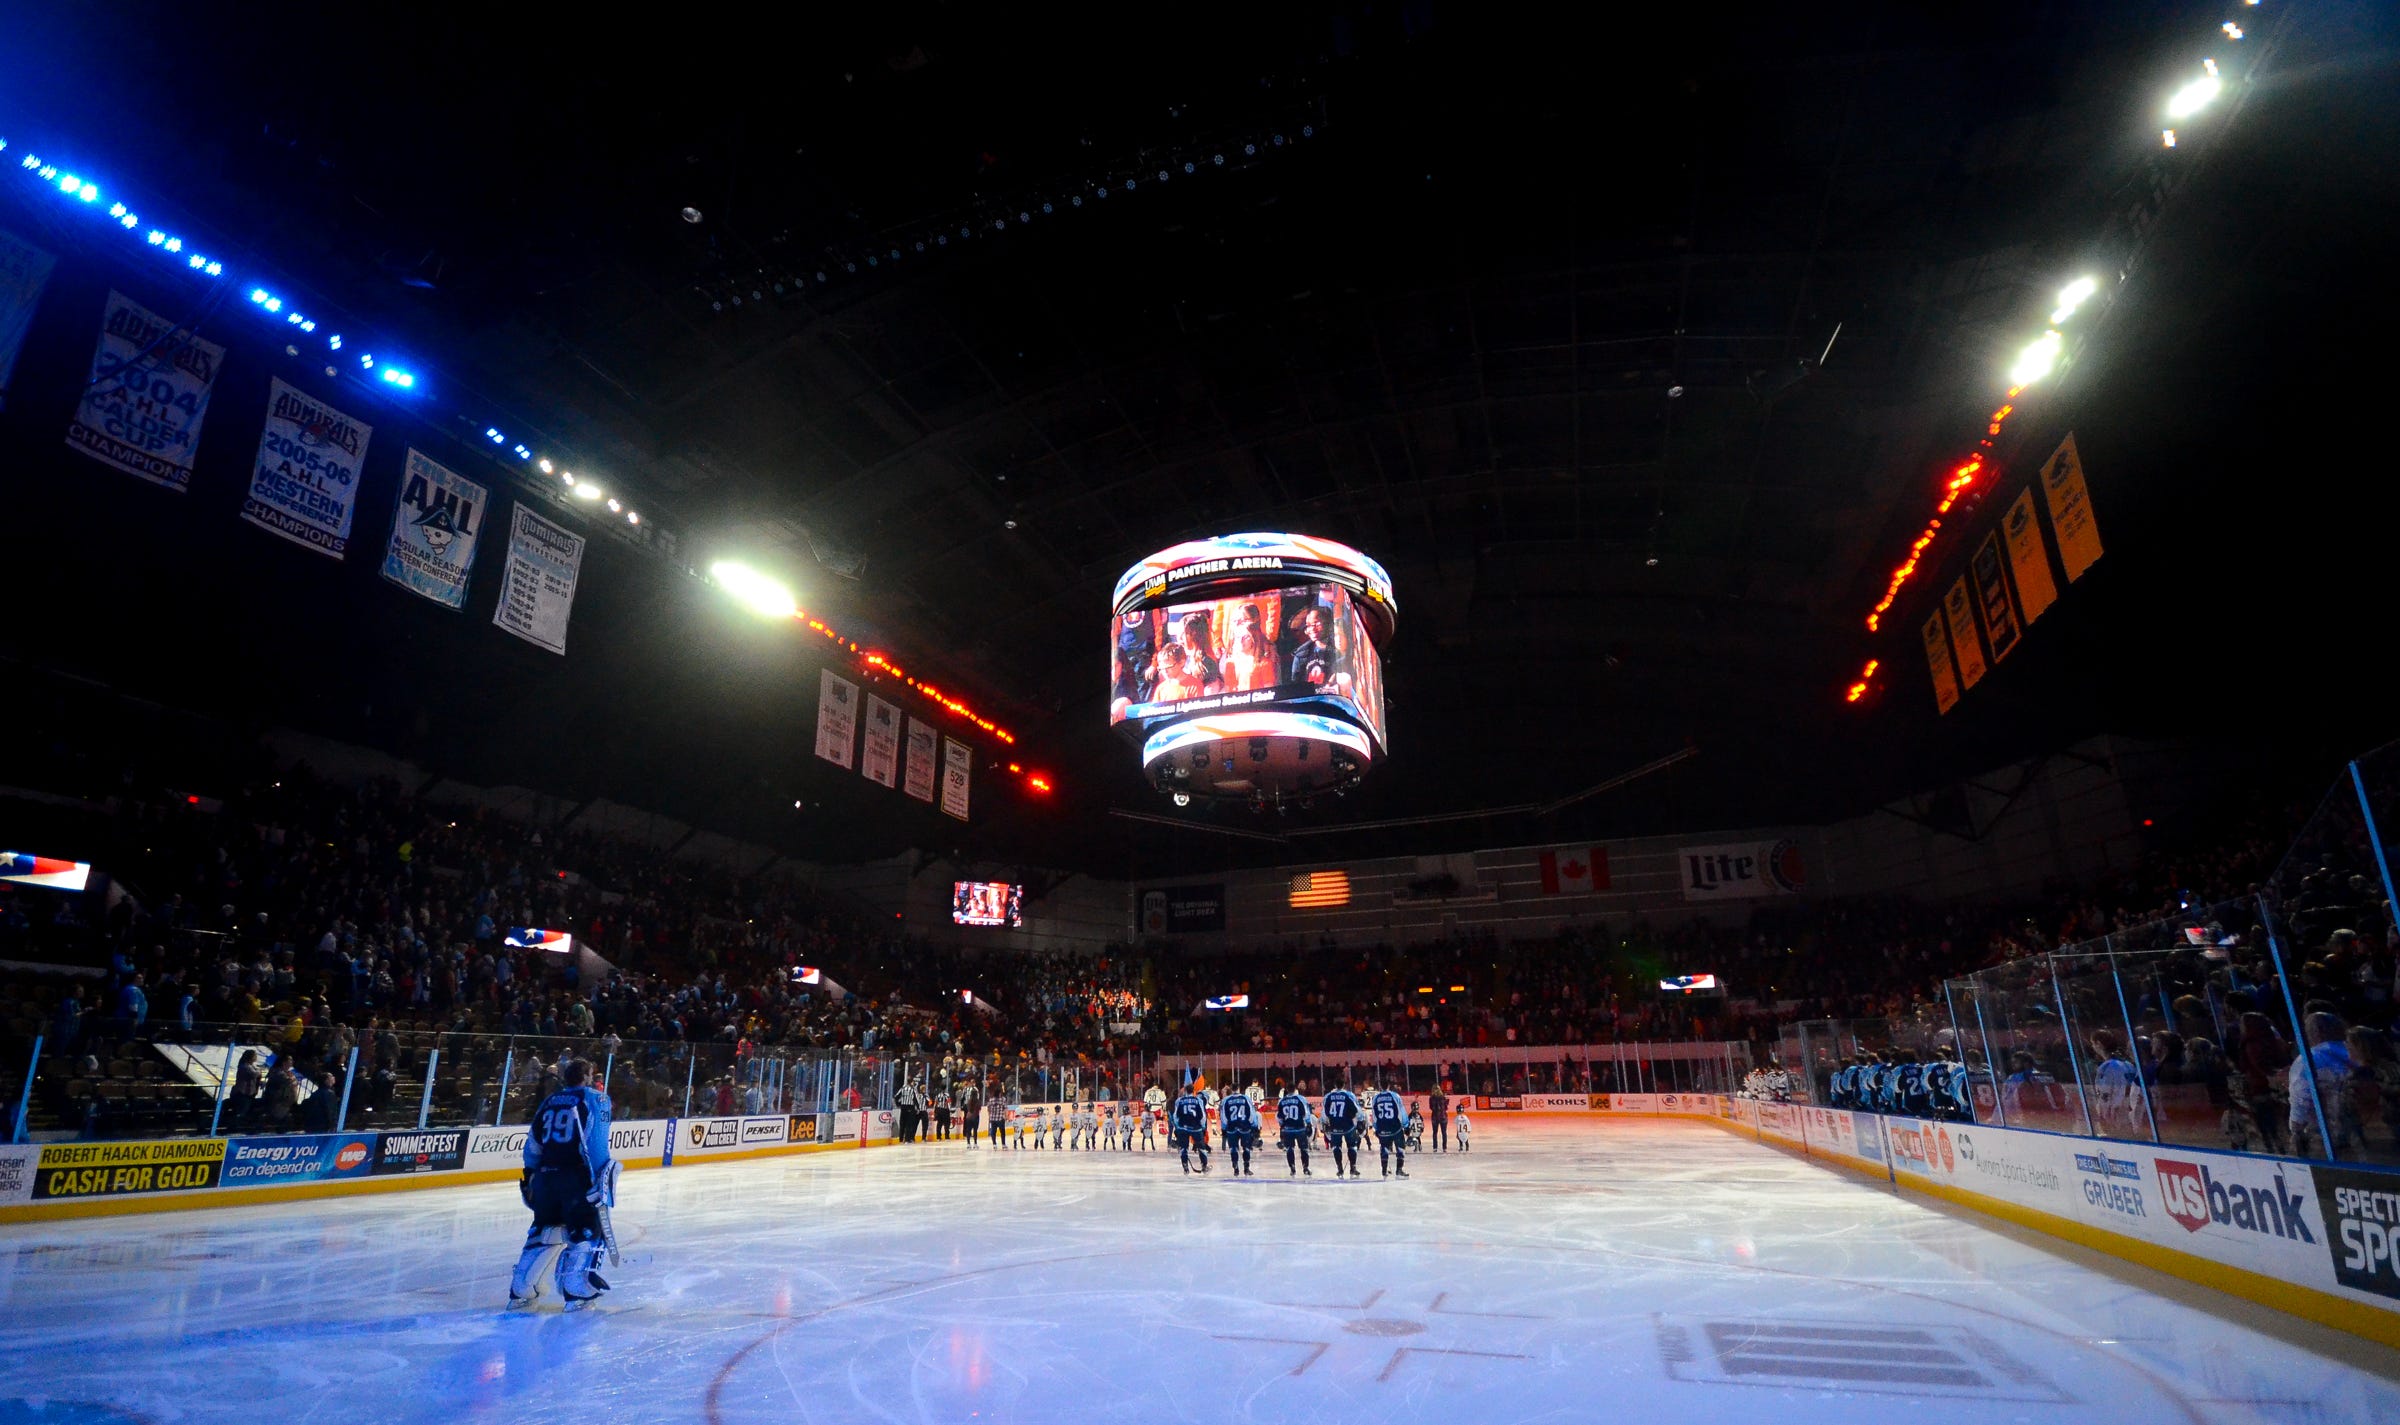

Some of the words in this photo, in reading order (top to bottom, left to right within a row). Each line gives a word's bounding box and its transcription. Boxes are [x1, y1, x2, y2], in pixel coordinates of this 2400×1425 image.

[96, 352, 198, 416] 2004
[90, 396, 189, 448] CALDER
[104, 418, 166, 451] CUP
[272, 392, 358, 458] ADMIRALS
[68, 423, 191, 483] CHAMPIONS
[266, 432, 352, 485] 2005-06
[254, 483, 341, 529] CONFERENCE
[258, 466, 344, 518] WESTERN
[402, 474, 473, 536] AHL
[244, 500, 345, 551] CHAMPIONS
[520, 513, 576, 558] ADMIRALS
[431, 552, 467, 577] SEASON
[1168, 559, 1229, 582] PANTHER
[1232, 557, 1283, 570] ARENA
[1685, 854, 1753, 890] Lite
[1183, 1104, 1196, 1117] 15
[1230, 1105, 1246, 1121] 24
[1329, 1101, 1345, 1118] 47
[1378, 1102, 1395, 1119] 55
[1523, 1097, 1544, 1109] Lee
[1547, 1098, 1587, 1106] KOHL'S
[1590, 1096, 1611, 1109] Lee
[541, 1109, 575, 1143] 39
[664, 1122, 674, 1155] CCM
[706, 1134, 719, 1146] OUR
[710, 1122, 724, 1134] OUR
[745, 1124, 782, 1135] PENSKE
[790, 1118, 815, 1140] Lee
[41, 1147, 99, 1163] ROBERT
[102, 1145, 150, 1161] HAACK
[152, 1142, 225, 1159] DIAMONDS
[235, 1145, 294, 1160] Energy
[294, 1145, 319, 1158] you
[385, 1134, 461, 1156] SUMMERFEST
[470, 1133, 528, 1154] LeafGu
[49, 1169, 108, 1195] CASH
[113, 1167, 152, 1192] FOR
[157, 1164, 209, 1188] GOLD
[229, 1164, 253, 1178] can
[256, 1162, 304, 1178] depend
[305, 1161, 321, 1172] on
[1975, 1155, 2001, 1177] Aurora
[2000, 1158, 2028, 1185] Sports
[2030, 1165, 2060, 1191] Health
[2083, 1178, 2147, 1217] GRUBER
